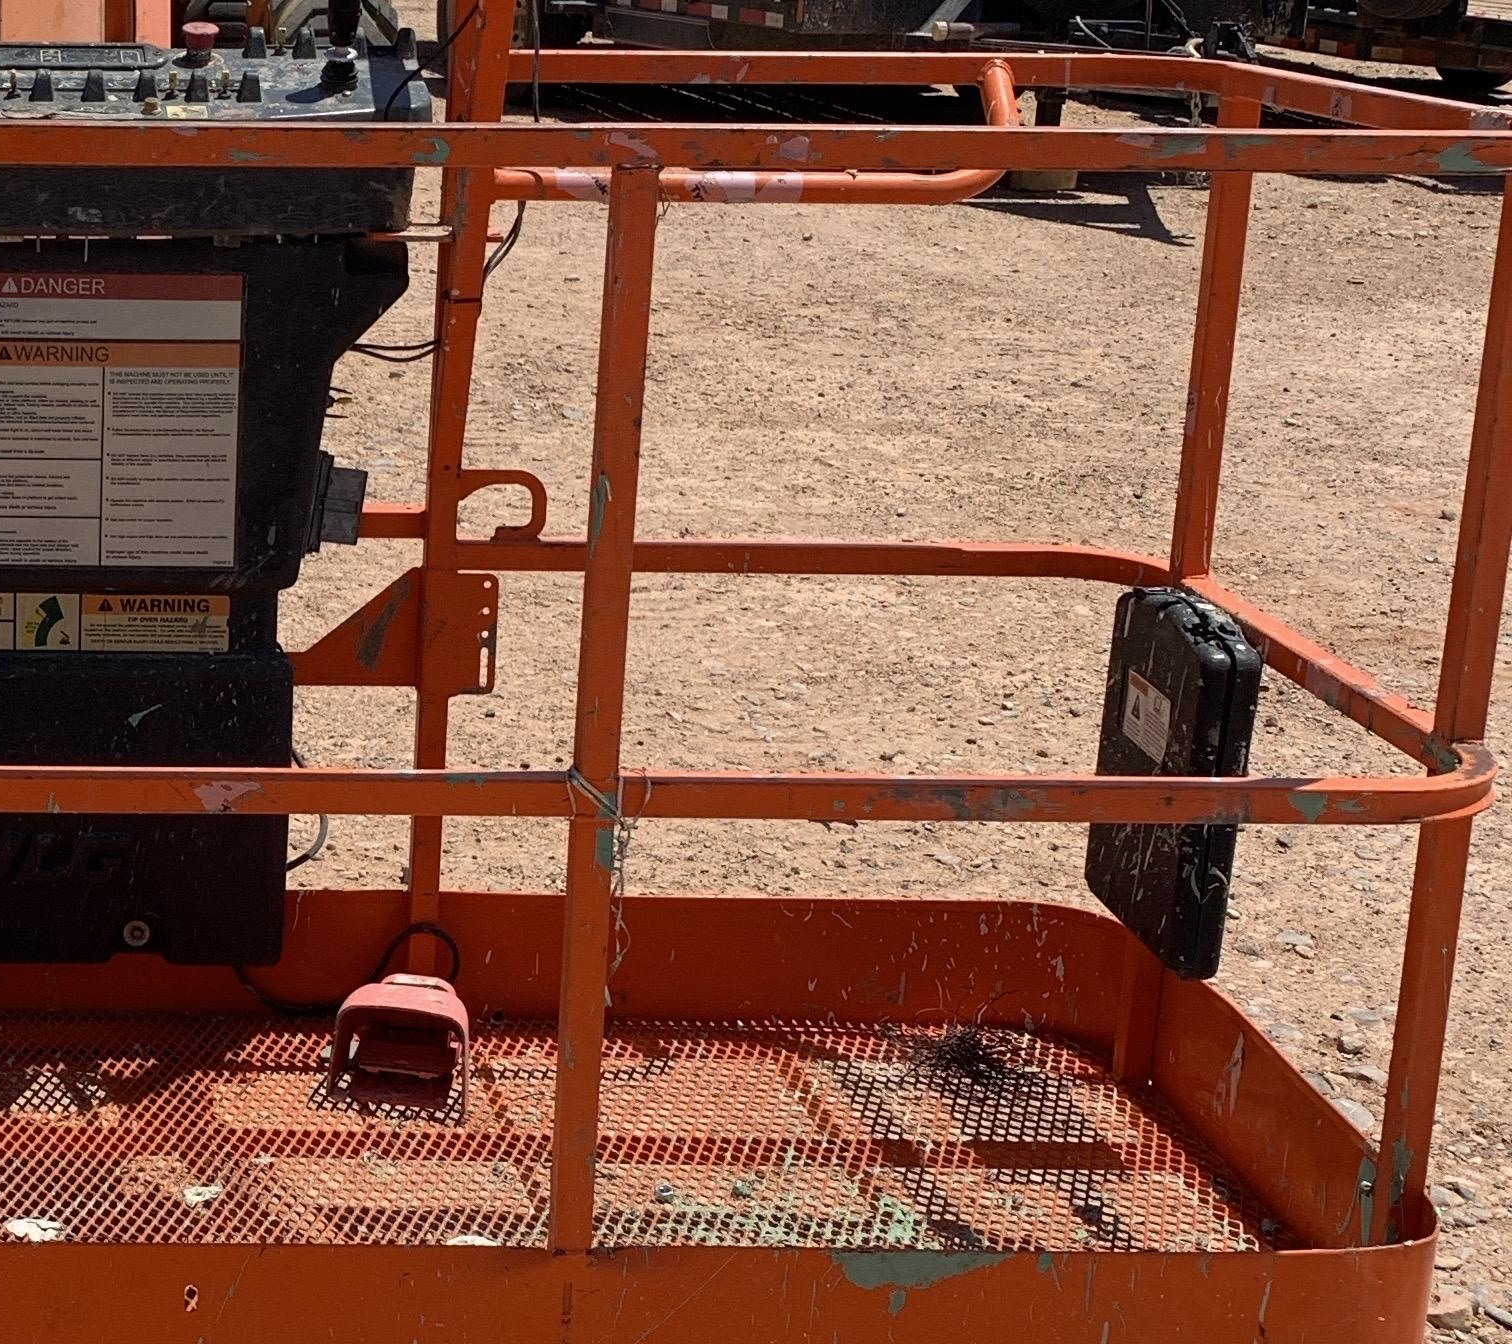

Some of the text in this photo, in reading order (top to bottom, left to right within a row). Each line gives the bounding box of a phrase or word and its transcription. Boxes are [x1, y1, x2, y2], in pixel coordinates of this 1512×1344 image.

[21, 277, 105, 295] DANGER
[14, 345, 110, 363] WARNING
[120, 598, 210, 613] WARNING
